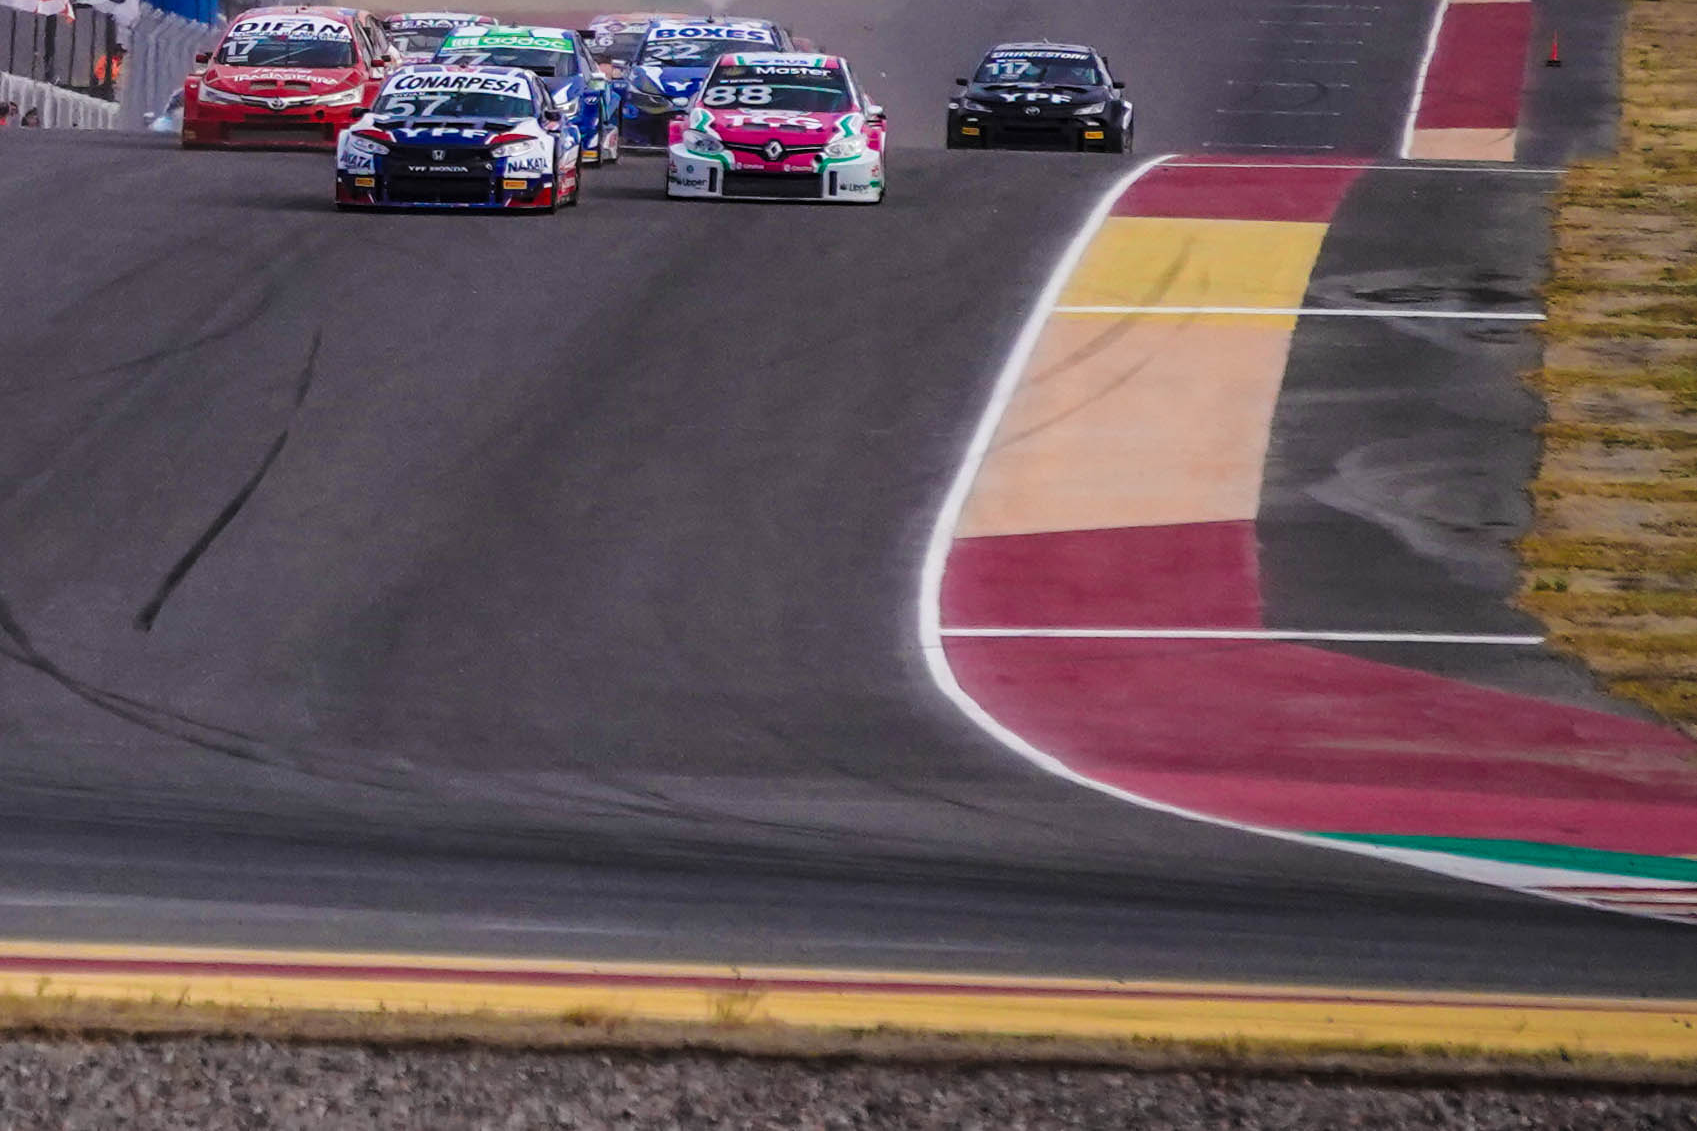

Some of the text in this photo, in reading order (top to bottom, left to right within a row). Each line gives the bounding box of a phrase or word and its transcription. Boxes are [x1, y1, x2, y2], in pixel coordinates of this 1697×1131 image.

[656, 28, 764, 41] BOXES
[222, 39, 259, 56] 17
[483, 37, 567, 49] addoc
[646, 44, 702, 60] 22
[756, 66, 832, 77] Master
[985, 62, 1032, 76] 117
[395, 75, 521, 94] CONARPESA
[703, 85, 773, 107] 88
[1000, 92, 1073, 104] YPF
[384, 95, 451, 117] 57
[399, 127, 488, 139] YPF
